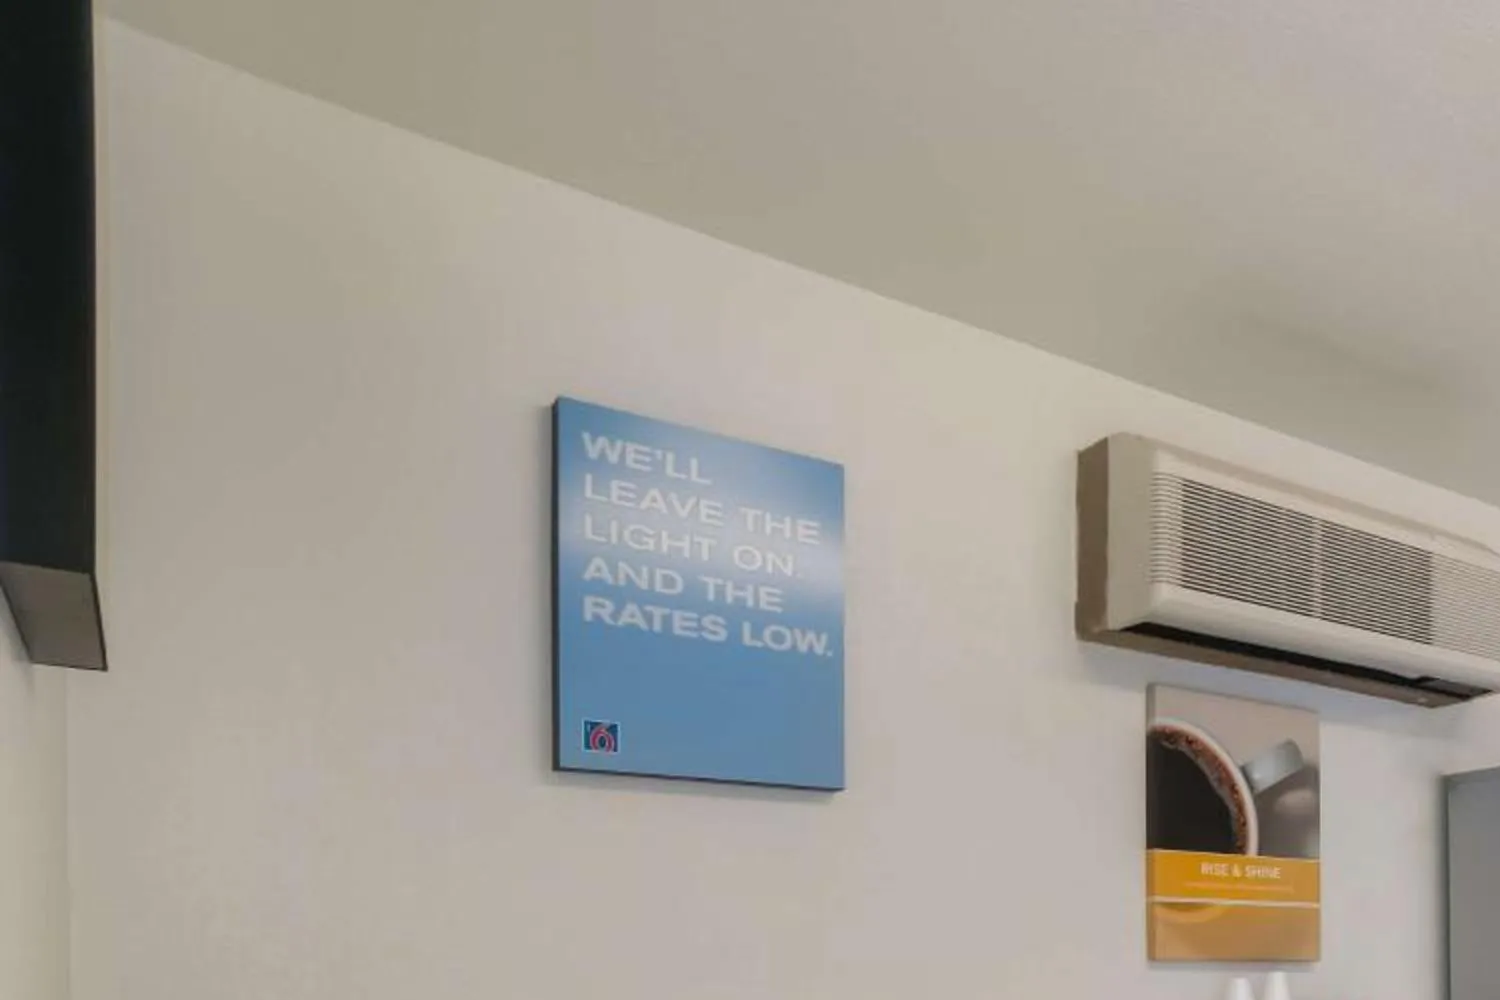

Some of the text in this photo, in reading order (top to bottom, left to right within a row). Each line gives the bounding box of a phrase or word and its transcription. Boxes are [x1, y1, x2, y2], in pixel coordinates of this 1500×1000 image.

[581, 431, 712, 485] WE'LL
[584, 473, 822, 545] LEAVE THE
[584, 515, 717, 562] LIGHT
[582, 557, 783, 613] AND THE
[582, 596, 834, 657] RATES LOW.
[1200, 862, 1229, 876] RISE
[1245, 865, 1281, 879] SHINE
